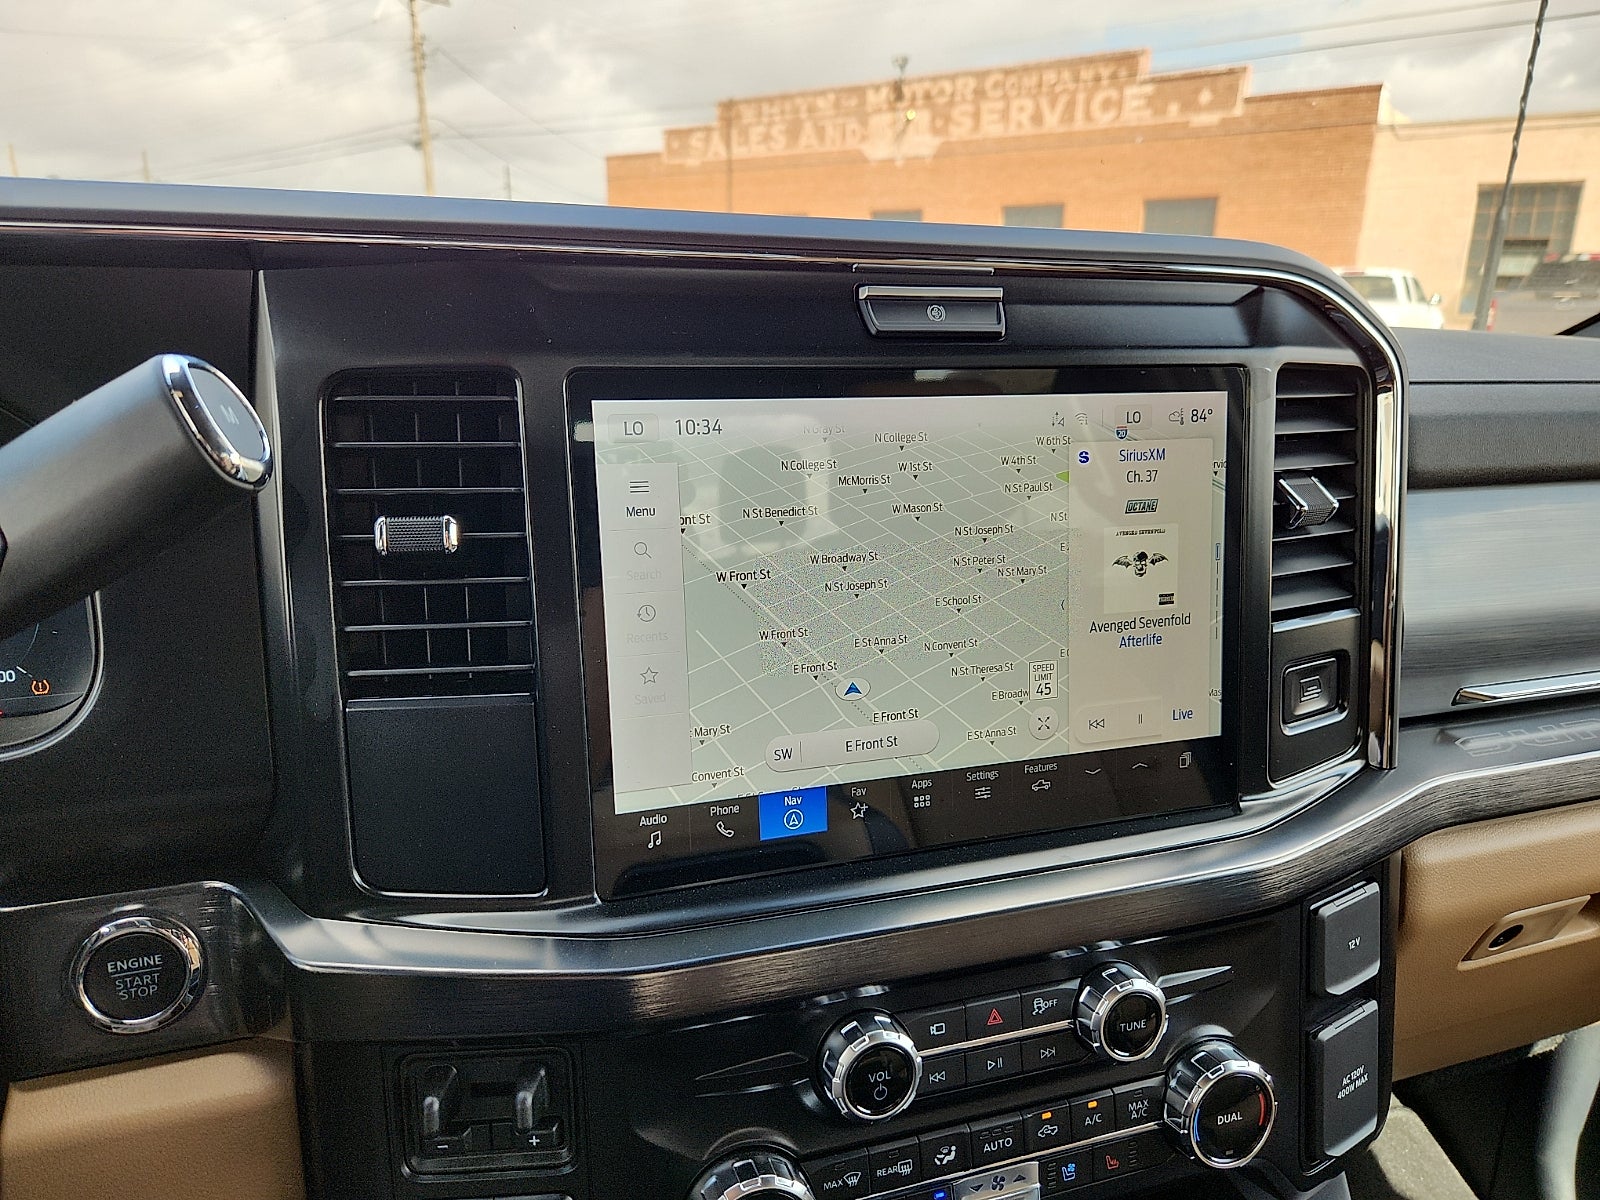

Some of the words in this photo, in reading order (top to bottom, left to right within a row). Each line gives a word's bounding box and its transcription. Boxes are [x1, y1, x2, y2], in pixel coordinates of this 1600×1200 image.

[950, 84, 1156, 135] SERVICE
[687, 121, 787, 160] SALES
[1126, 411, 1142, 424] LO
[623, 420, 645, 436] LO
[675, 419, 723, 436] 10:34
[835, 424, 846, 434] St
[875, 434, 882, 442] N
[884, 433, 916, 444] College
[918, 432, 928, 442] St
[1036, 436, 1045, 446] W
[1046, 436, 1060, 446] 6th
[1062, 436, 1072, 445] St
[1001, 456, 1010, 466] W
[1011, 456, 1026, 465] 4th
[1028, 455, 1037, 465] St
[1119, 448, 1166, 462] SiriusXM
[781, 461, 788, 471] N
[790, 460, 824, 472] College
[826, 459, 838, 469] St
[898, 462, 908, 472] W
[922, 462, 933, 471] St
[838, 476, 879, 486] McMorris
[881, 475, 891, 485] St
[1126, 470, 1144, 483] Ch.
[1145, 470, 1158, 482] 37
[1004, 484, 1011, 493] N
[1012, 484, 1022, 492] St
[1024, 482, 1042, 492] Paul
[1044, 482, 1052, 491] St
[626, 506, 656, 518] Menu
[743, 508, 750, 518] N
[752, 508, 763, 518] St
[765, 507, 806, 518] Benedict
[808, 506, 819, 516] St
[892, 504, 902, 514] W
[904, 503, 932, 513] Mason
[934, 502, 944, 512] St
[1126, 500, 1157, 513] OCTANE
[699, 513, 711, 525] St
[1050, 512, 1057, 522] N
[954, 526, 962, 536] N
[963, 526, 972, 536] St
[974, 525, 1003, 536] Joseph
[1004, 524, 1014, 534] St
[810, 555, 820, 564] W
[822, 553, 866, 564] Broadway
[868, 552, 878, 561] St
[954, 558, 960, 566] N
[962, 558, 971, 566] St
[972, 556, 994, 566] Peter
[997, 554, 1006, 564] St
[626, 568, 662, 581] Search
[716, 572, 728, 582] W
[730, 570, 758, 582] Front
[760, 569, 772, 580] St
[998, 568, 1004, 576] N
[1006, 568, 1015, 576] St
[1016, 566, 1037, 576] Mary
[1038, 566, 1047, 574] St
[824, 583, 832, 592] N
[834, 582, 844, 592] St
[846, 580, 876, 592] Joseph
[878, 579, 888, 588] St
[936, 598, 941, 606] E
[943, 596, 971, 606] School
[972, 594, 982, 604] St
[1090, 617, 1137, 634] Avenged
[1139, 612, 1191, 629] Sevenfold
[627, 631, 669, 644] Recents
[759, 630, 770, 640] W
[772, 629, 796, 640] Front
[798, 628, 808, 638] St
[1118, 633, 1163, 648] Afterlife
[854, 638, 860, 648] E
[862, 638, 872, 647] St
[874, 636, 896, 646] Anna
[898, 634, 908, 644] St
[924, 643, 931, 652] N
[932, 640, 967, 650] Convent
[968, 638, 978, 648] St
[794, 665, 800, 674] E
[801, 663, 826, 674] Front
[828, 662, 838, 671] St
[952, 668, 958, 676] N
[960, 666, 969, 676] St
[970, 664, 1004, 675] Theresa
[1004, 662, 1014, 672] St
[1032, 663, 1055, 673] SPEED
[1034, 672, 1054, 682] LIMIT
[1036, 682, 1052, 696] 45
[634, 692, 667, 705] Saved
[992, 692, 997, 700] E
[873, 712, 880, 722] E
[882, 711, 906, 722] Front
[908, 708, 919, 719] St
[1172, 709, 1194, 720] Live
[694, 726, 718, 738] Mary
[720, 724, 730, 735] St
[968, 732, 973, 740] E
[974, 730, 984, 740] St
[986, 728, 1006, 738] Anna
[1008, 726, 1017, 736] St
[846, 741, 852, 752] E
[855, 738, 884, 752] Front
[886, 736, 898, 748] St
[774, 748, 793, 761] SW
[691, 769, 732, 782] Convent
[734, 766, 744, 777] St
[1024, 762, 1058, 774] Features
[966, 769, 1000, 782] Settings
[912, 779, 933, 790] Apps
[851, 786, 867, 797] Fav
[784, 795, 803, 806] Nav
[710, 804, 740, 816] Phone
[639, 814, 668, 826] Audio
[107, 954, 163, 973] ENGINE
[116, 973, 160, 990] START
[119, 985, 158, 1000] STOP
[1042, 999, 1058, 1009] OFF
[1120, 1019, 1147, 1032] TUNE
[868, 1071, 892, 1084] VOL
[1342, 1074, 1350, 1086] AC
[1351, 1065, 1364, 1080] 120V
[1337, 1082, 1355, 1099] 400W
[1356, 1073, 1368, 1088] MAX
[1128, 1099, 1150, 1112] MAX
[1084, 1113, 1102, 1126] A/C
[1130, 1108, 1148, 1120] A/C
[1216, 1112, 1243, 1125] DUAL
[984, 1138, 1012, 1153] AUTO
[876, 1166, 898, 1178] REAR
[823, 1180, 844, 1191] MAX
